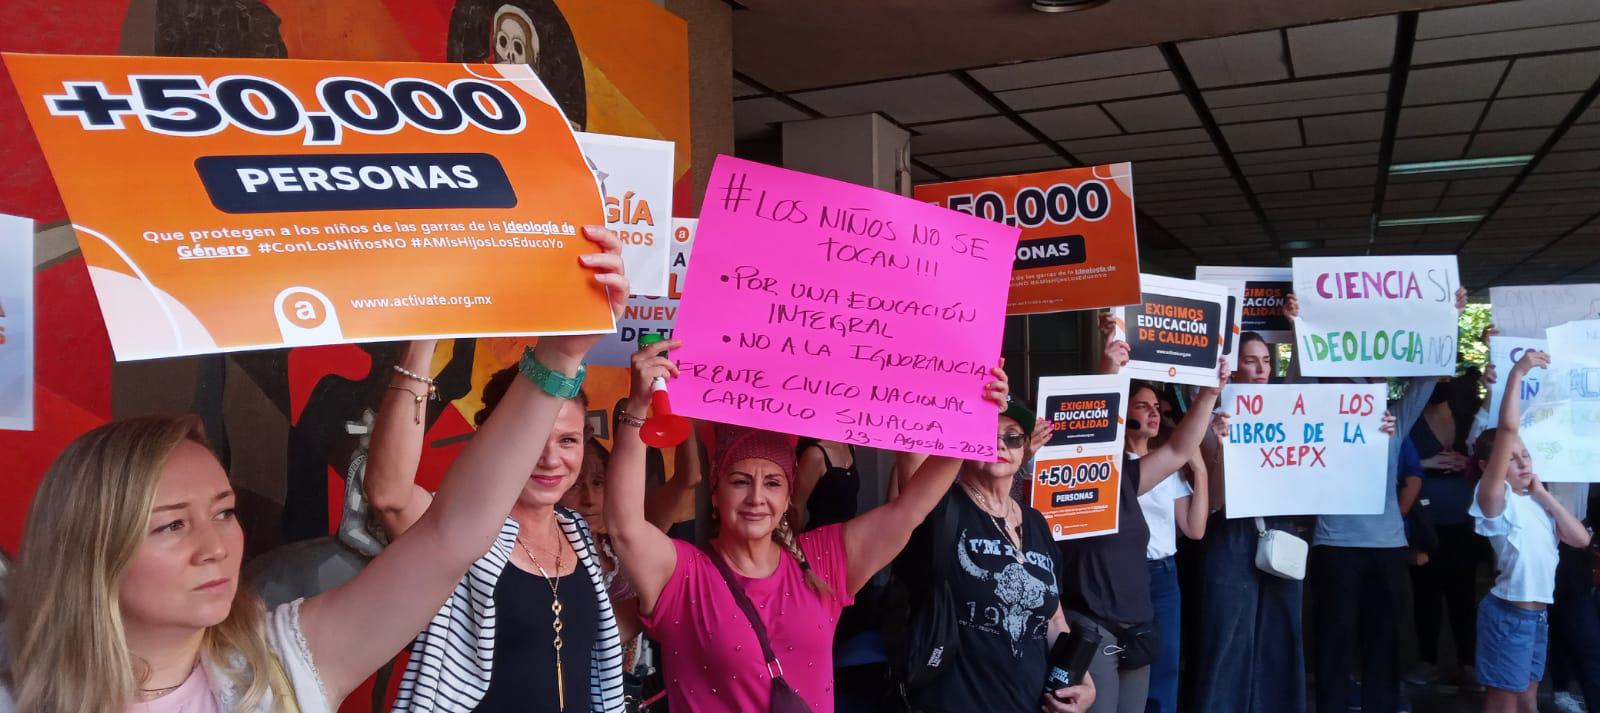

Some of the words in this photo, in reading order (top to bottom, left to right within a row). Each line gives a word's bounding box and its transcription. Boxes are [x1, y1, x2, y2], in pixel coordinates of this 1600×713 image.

[43, 74, 527, 146] +50,000
[237, 165, 479, 194] PERSONAS
[142, 231, 185, 244] Que
[189, 226, 276, 243] protegen
[280, 226, 291, 236] a
[294, 224, 320, 236] los
[324, 223, 368, 235] niños
[372, 222, 392, 234] de
[396, 221, 417, 233] las
[421, 222, 465, 235] garras
[469, 221, 486, 232] de
[488, 221, 500, 231] la
[503, 220, 559, 235] Ideología
[561, 222, 576, 235] de
[820, 206, 897, 241] NIÑOS
[912, 224, 941, 247] NO
[951, 234, 989, 261] SE
[177, 244, 251, 260] Género
[258, 238, 407, 254] #ConLosNiñosNO
[411, 237, 564, 250] #AMisHijosLosEducoYo
[817, 236, 939, 278] TOCAN!!!
[734, 265, 778, 296] POR
[791, 283, 841, 305] UNA
[847, 290, 977, 324] EDUCACIÓN
[1315, 270, 1423, 299] CIENCIA
[1426, 268, 1450, 302] SI
[294, 300, 316, 320] a
[351, 294, 493, 309] www.activate.org.mx
[1145, 302, 1205, 321] EXIGIMOS
[767, 303, 894, 339] INTEGRAL
[1137, 314, 1208, 335] EDUCACIÓN
[1138, 328, 1155, 342] DE
[1158, 331, 1209, 349] CALIDAD
[1302, 329, 1424, 363] IDEOLOGIA
[1426, 335, 1452, 367] NO
[739, 332, 771, 351] NO
[781, 337, 797, 356] A
[803, 339, 832, 358] LA
[850, 344, 988, 381] IGNORANCIA
[676, 360, 770, 390] FRENTE
[782, 374, 860, 399] CIVICO
[870, 388, 973, 415] NACIONAL
[702, 388, 816, 420] CAPITULO
[836, 408, 944, 434] SINALOA
[1053, 408, 1109, 421] EDUCACIÓN
[1060, 400, 1107, 411] EXIGIMOS
[1235, 394, 1264, 416] NO
[1292, 393, 1306, 415] A
[1339, 393, 1375, 416] LOS
[1054, 421, 1067, 431] DE
[1068, 419, 1109, 430] CALIDAD
[1228, 422, 1287, 445] LIBROS
[1303, 422, 1325, 443] DE
[1343, 422, 1366, 445] LA
[1259, 445, 1327, 468] XSEPX
[1038, 462, 1111, 488] +50,000
[1055, 491, 1094, 503] PERSONAS
